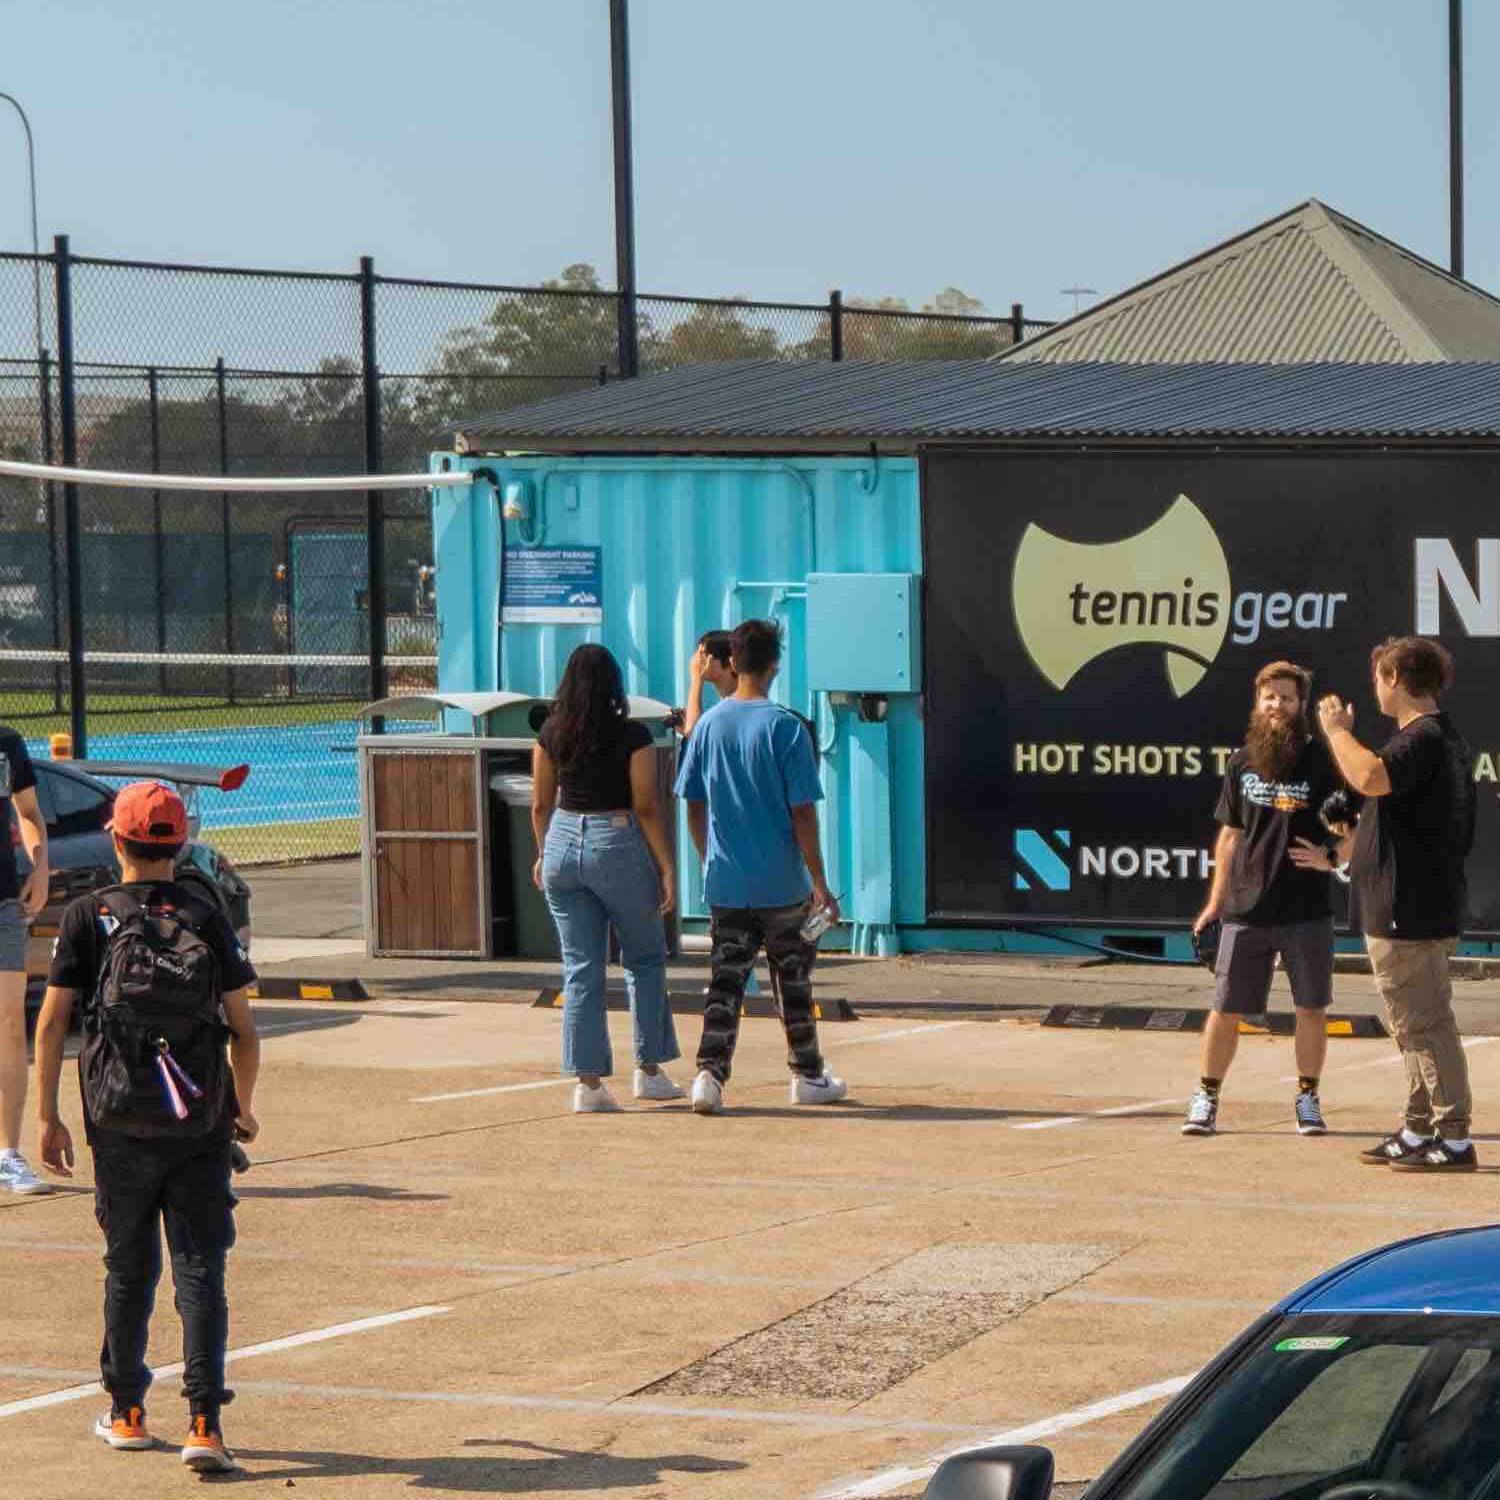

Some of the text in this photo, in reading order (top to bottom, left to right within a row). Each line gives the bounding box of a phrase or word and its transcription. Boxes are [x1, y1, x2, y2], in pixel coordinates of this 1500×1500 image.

[1069, 577, 1348, 645] tennis gear
[1015, 743, 1084, 774] HOT
[1093, 744, 1202, 776] SHOTS
